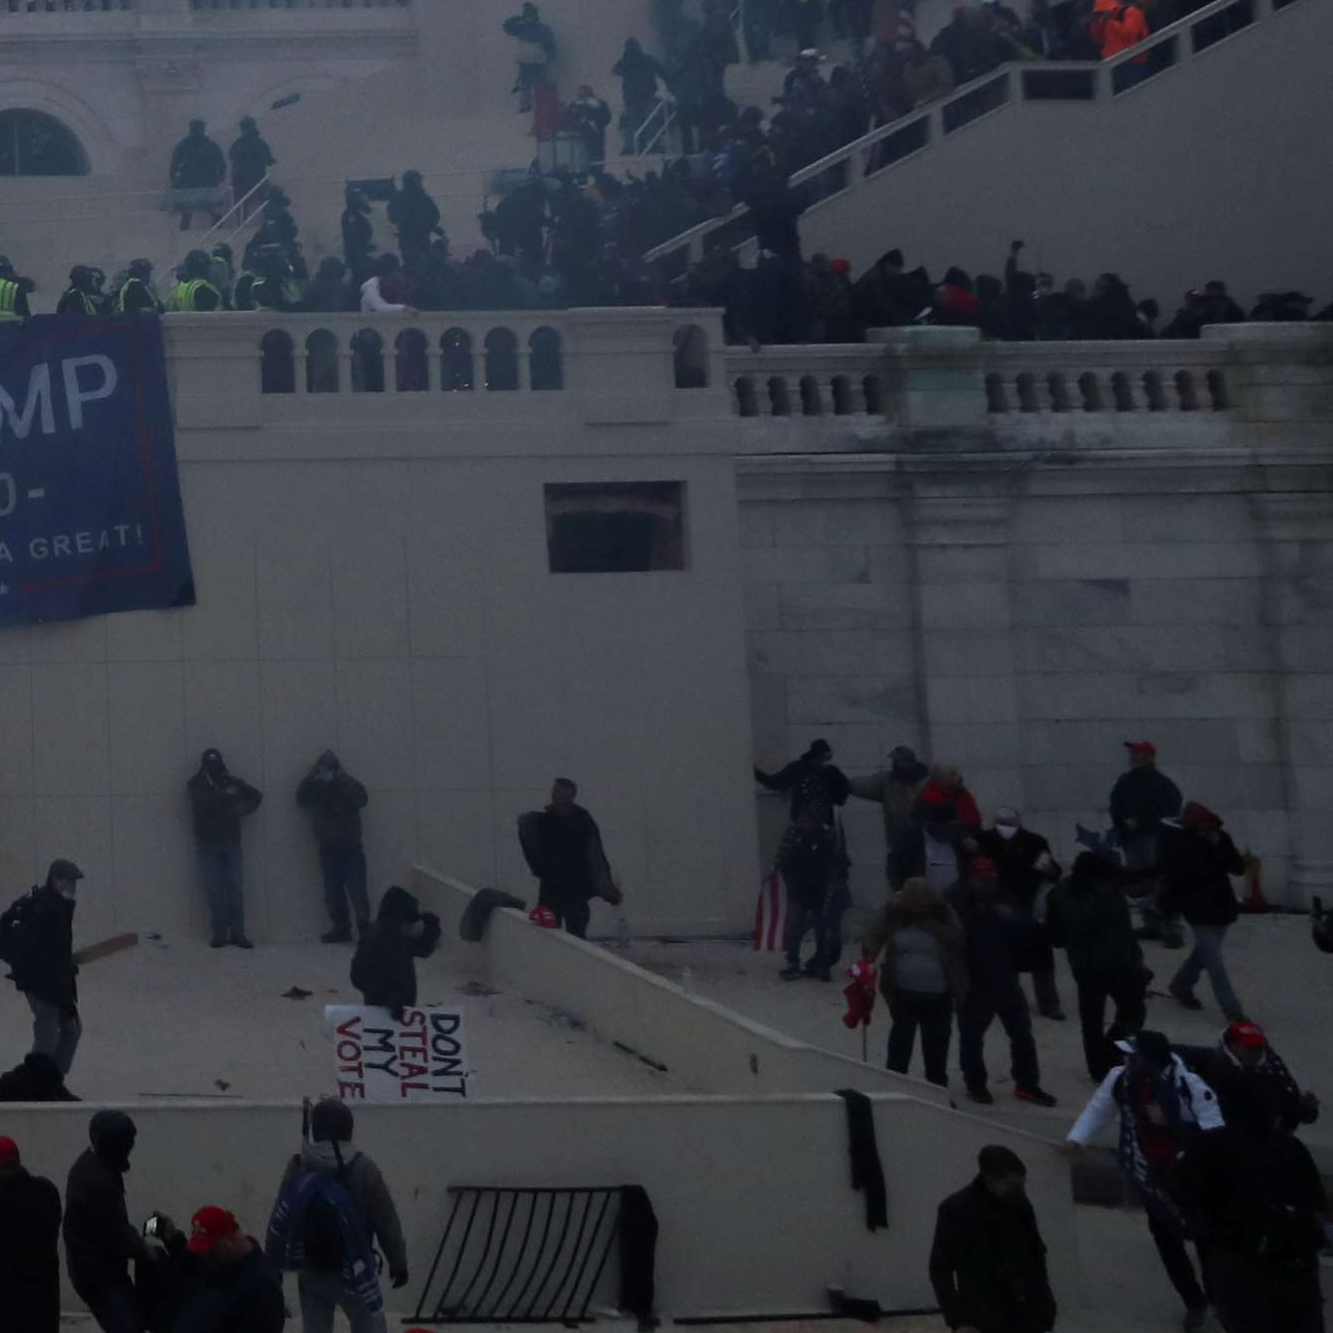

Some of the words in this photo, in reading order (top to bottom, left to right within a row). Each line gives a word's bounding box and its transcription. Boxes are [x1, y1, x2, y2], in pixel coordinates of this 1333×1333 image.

[29, 524, 144, 559] GREAT!
[336, 1016, 366, 1099] VOTE
[363, 1027, 400, 1078] MY
[398, 1007, 430, 1098] STEAL
